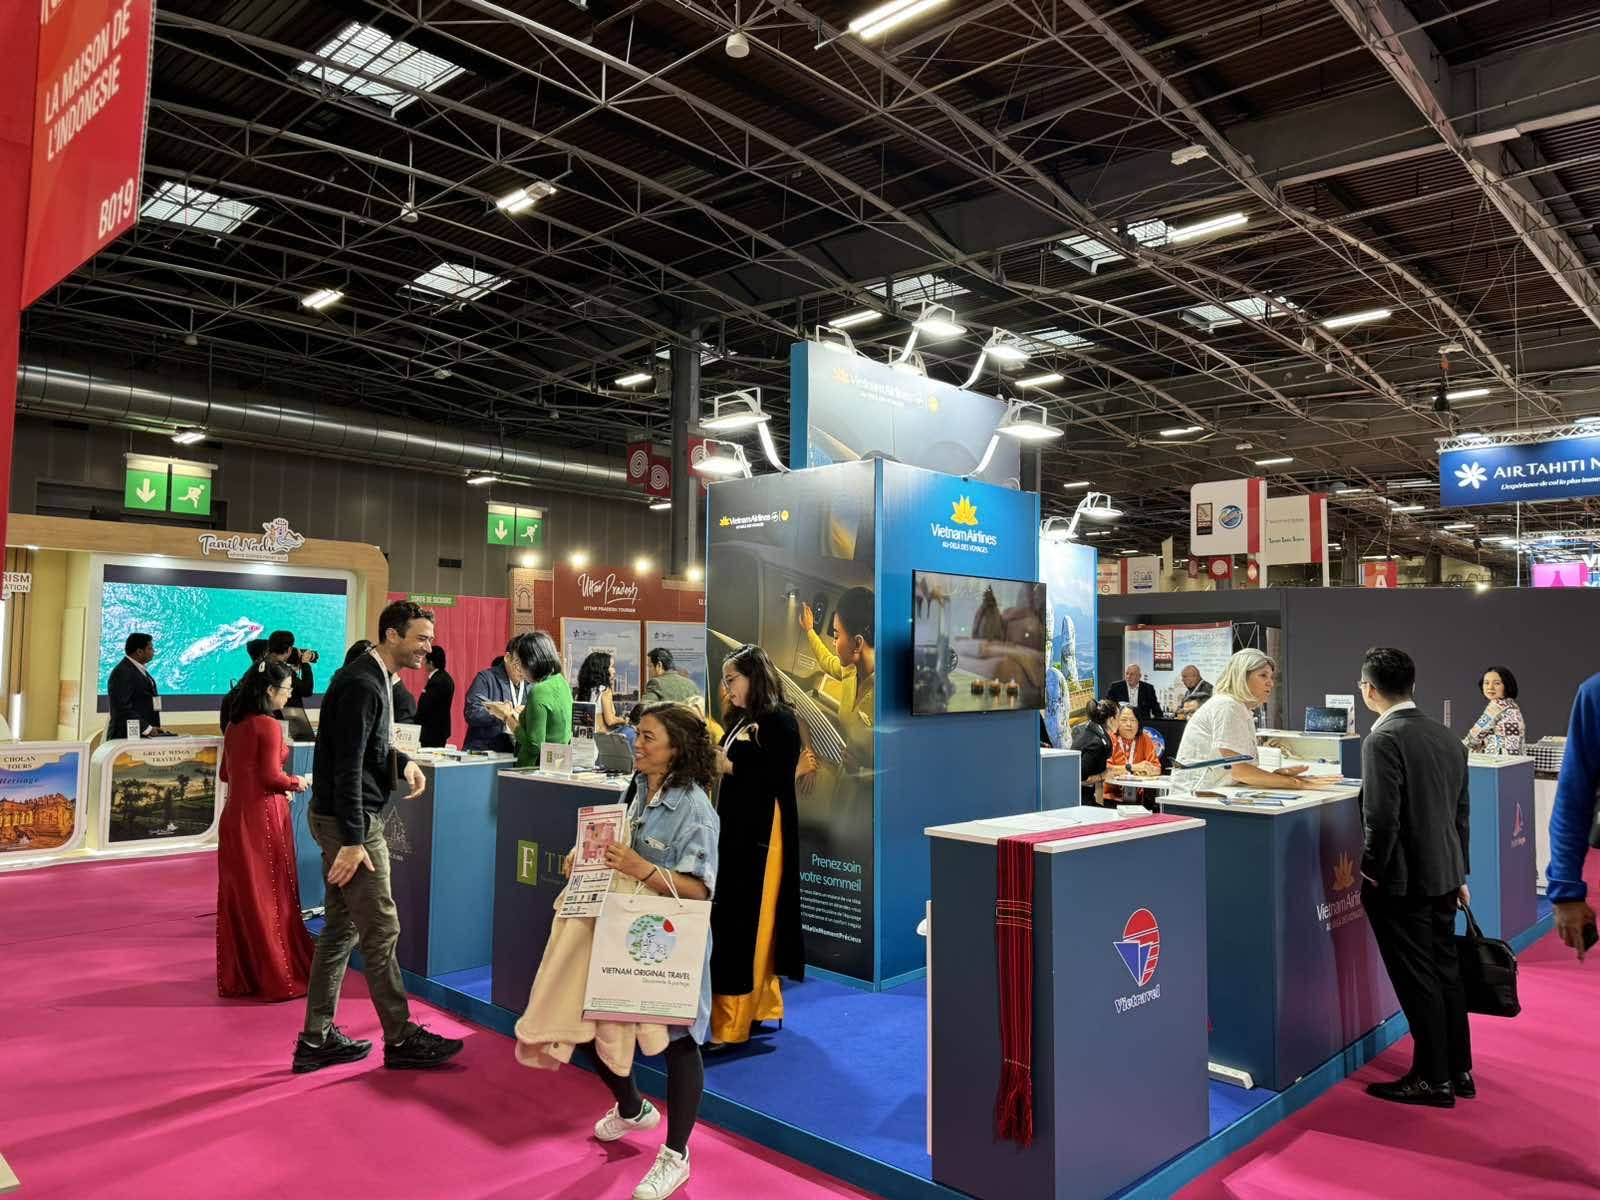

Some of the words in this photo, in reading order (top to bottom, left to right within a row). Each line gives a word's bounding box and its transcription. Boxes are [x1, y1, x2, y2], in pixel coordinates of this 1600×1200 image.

[45, 82, 58, 124] LA
[61, 22, 110, 107] MAISON
[112, 0, 131, 50] DE
[98, 178, 134, 240] B019
[1493, 466, 1526, 479] AIR
[1526, 459, 1585, 476] TAHITI
[200, 535, 237, 553] Tamil
[240, 538, 275, 552] Nadu
[604, 573, 640, 605] Pradesh
[811, 853, 841, 871] Prenez
[843, 860, 862, 874] soin
[800, 871, 822, 884] votre
[823, 876, 862, 892] sommeil
[602, 967, 632, 976] VIETNAM
[634, 968, 666, 978] ORIGINAL
[668, 971, 690, 980] TRAVEL
